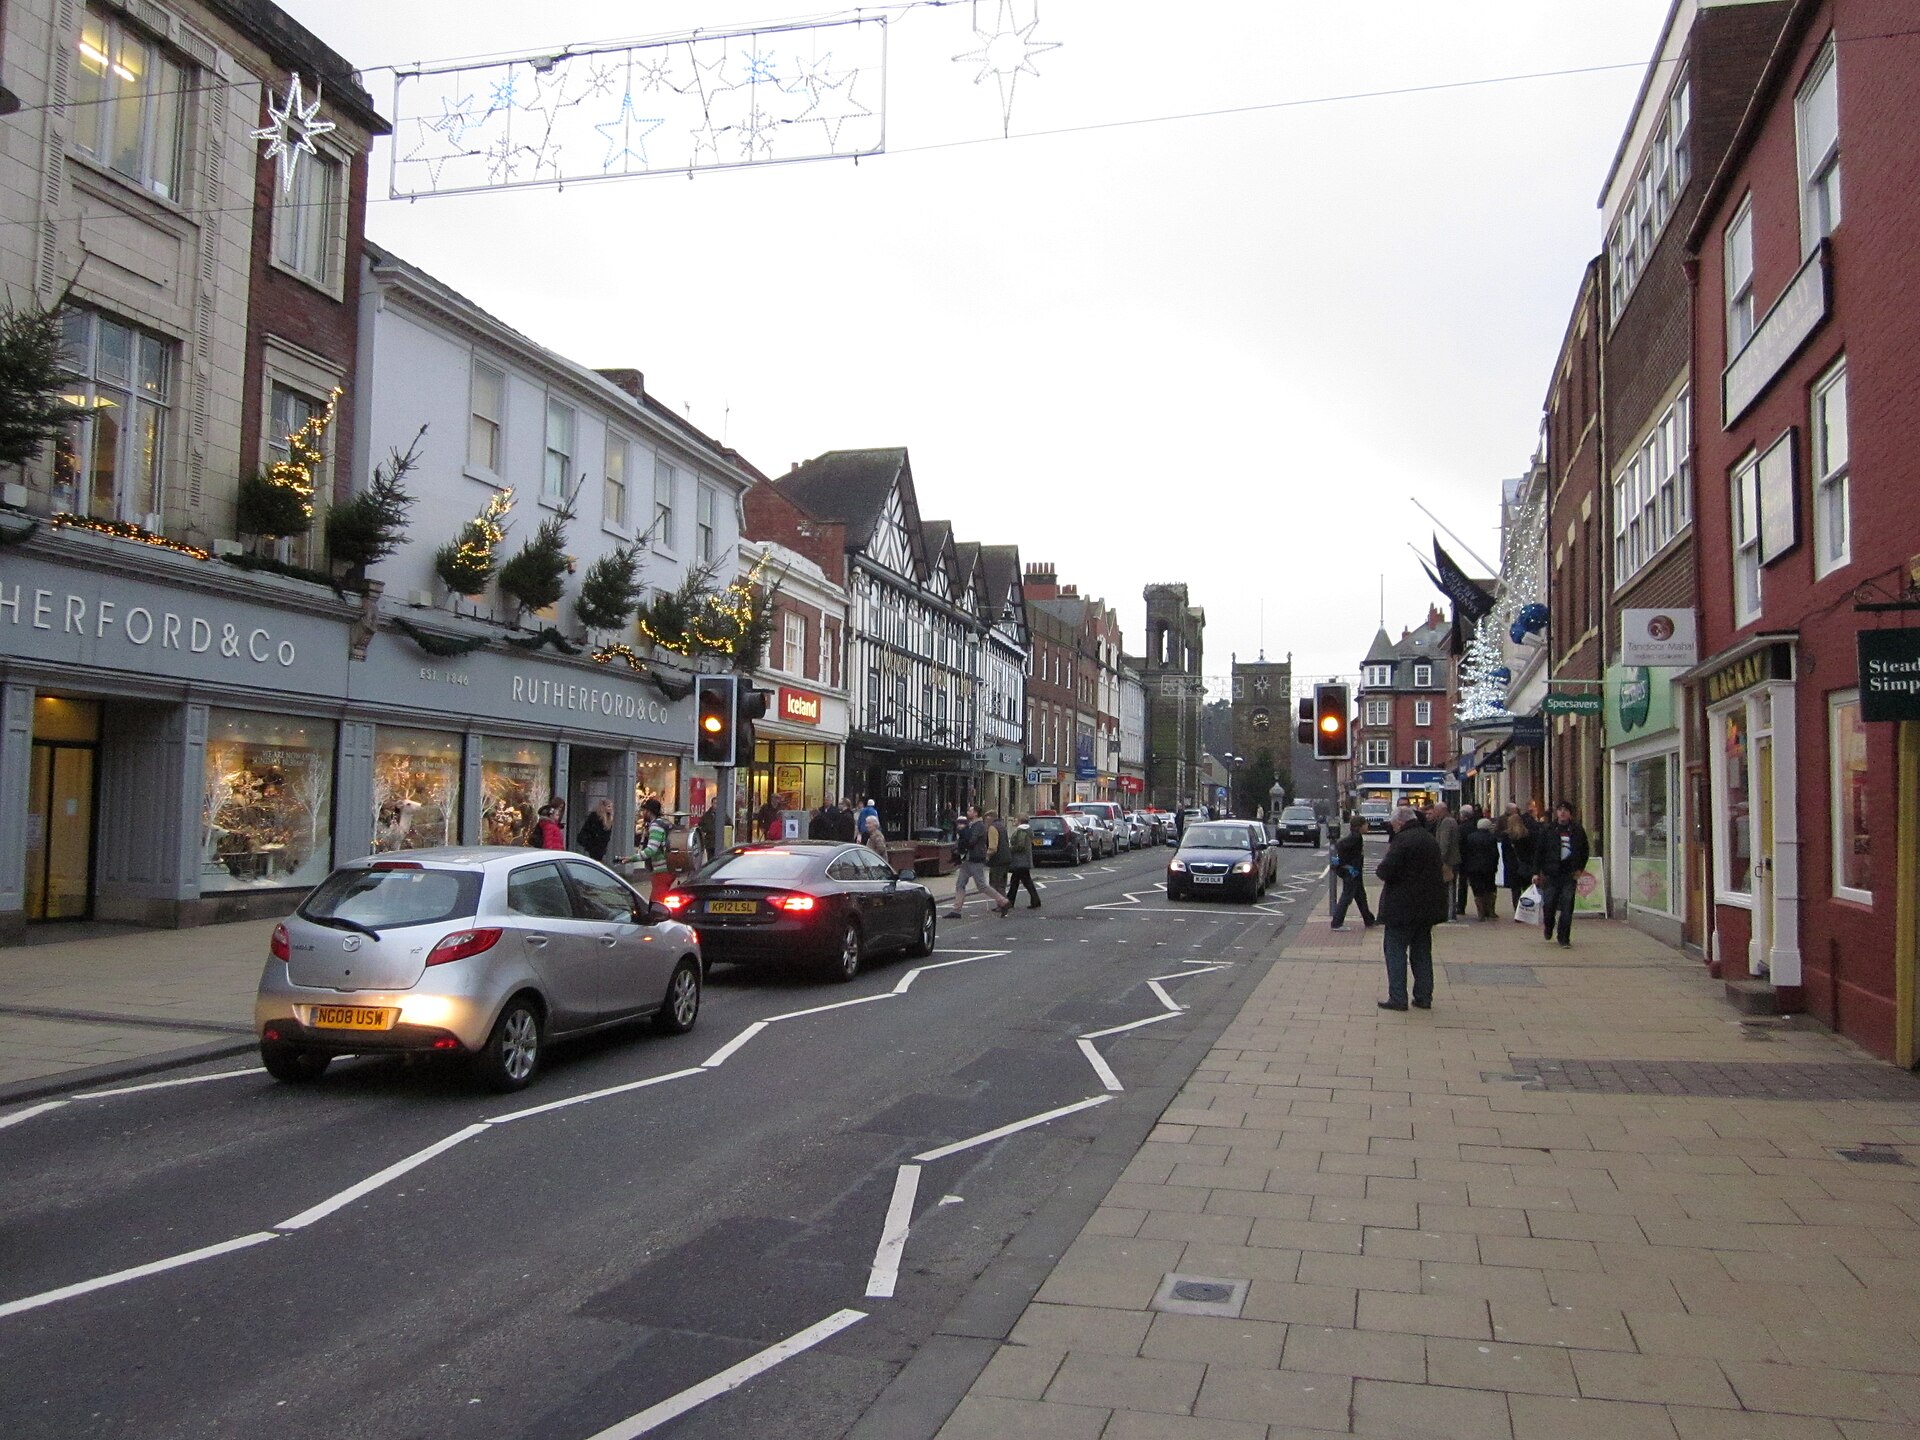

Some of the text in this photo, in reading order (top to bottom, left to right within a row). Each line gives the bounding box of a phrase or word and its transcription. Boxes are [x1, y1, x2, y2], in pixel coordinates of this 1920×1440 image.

[787, 693, 817, 718] Iceland
[1547, 698, 1599, 710] Specsavers
[711, 903, 753, 912] KP12 LSL
[318, 1008, 384, 1026] NG08 USW
